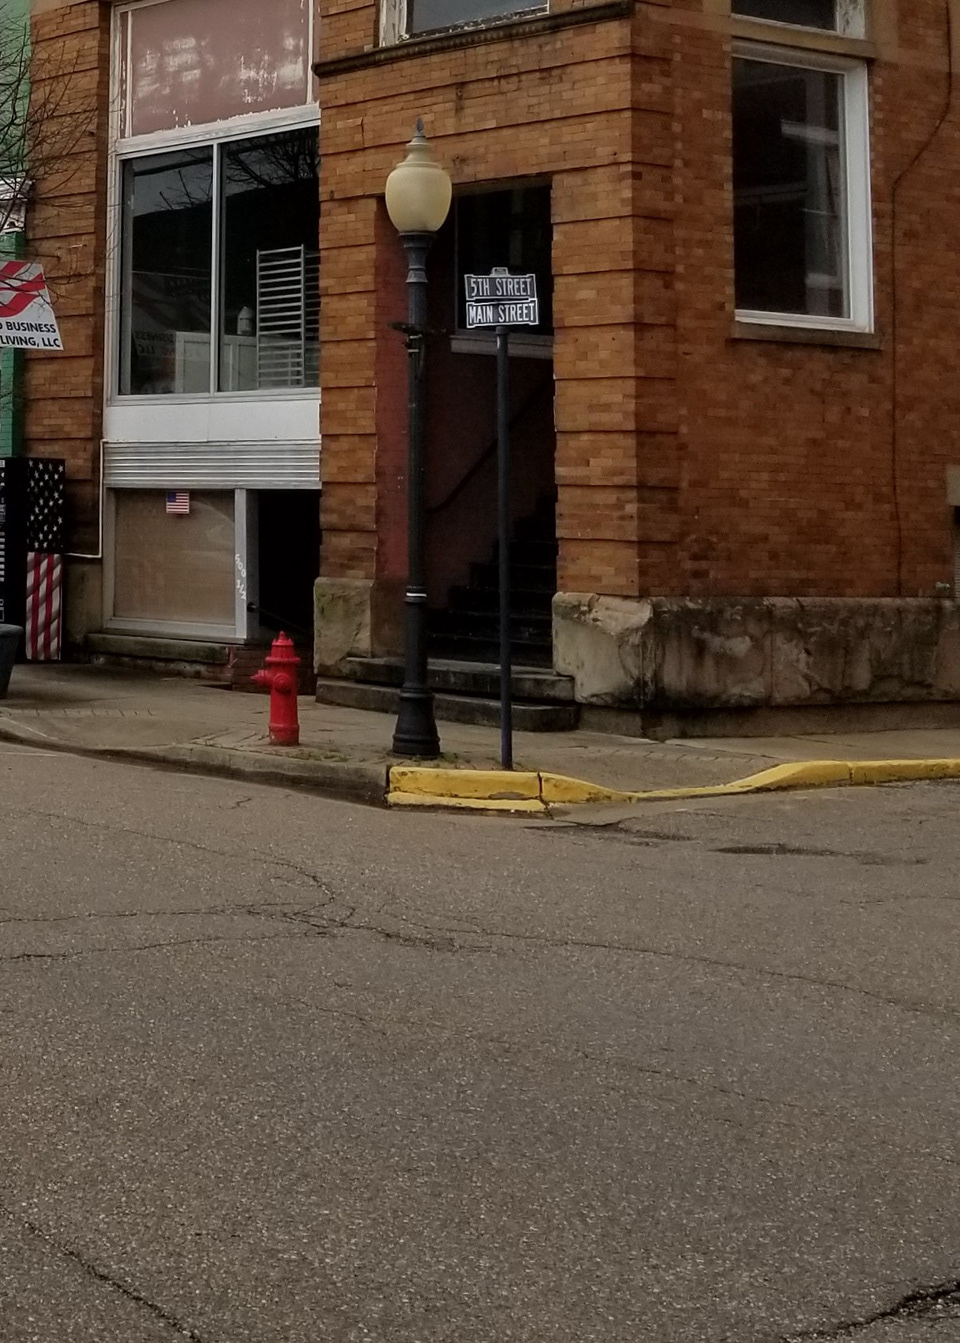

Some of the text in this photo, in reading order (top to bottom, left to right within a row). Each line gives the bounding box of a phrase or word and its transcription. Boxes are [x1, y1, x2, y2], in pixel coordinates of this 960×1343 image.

[470, 278, 532, 296] 5TH STREET
[469, 303, 535, 324] MAIN STREET
[6, 321, 56, 333] BUSINESS
[0, 335, 40, 348] LIVING,
[41, 337, 61, 348] LLC
[235, 553, 247, 578] 500
